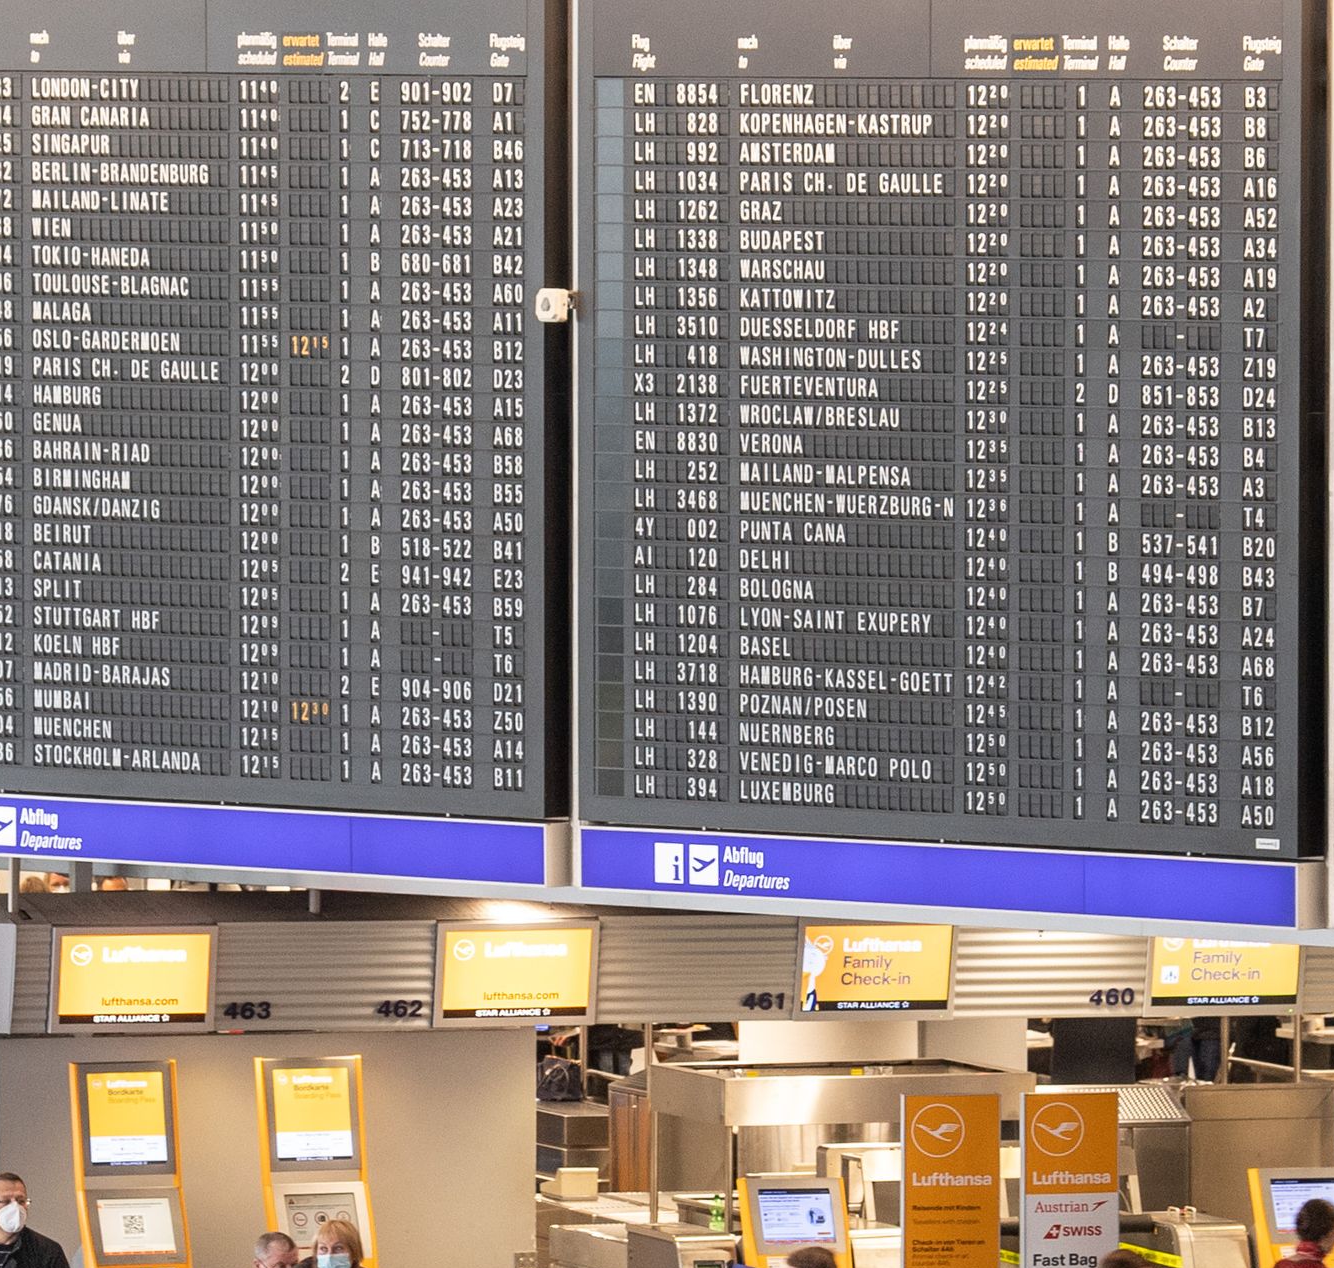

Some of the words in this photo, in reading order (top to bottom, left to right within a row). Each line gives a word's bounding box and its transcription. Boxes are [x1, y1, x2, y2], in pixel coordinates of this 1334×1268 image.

[30, 77, 140, 99] LONDON-CITY
[400, 81, 473, 103] 901-902
[492, 82, 514, 103] D7
[634, 112, 656, 133] LH
[686, 112, 719, 133] 828
[738, 112, 934, 135] KOPENHAGEN-KASTRUP
[1142, 115, 1222, 138] 263-453
[1243, 116, 1267, 138] B8
[31, 133, 111, 155] SINGAPUR
[738, 142, 836, 164] AMSTERDAM
[30, 161, 210, 185] BERLIN-BRANDENBURG
[739, 200, 783, 221] GRAZ
[30, 217, 72, 238] WIEN
[738, 229, 826, 251] BUDAPEST
[31, 300, 93, 322] MALAGA
[32, 384, 102, 406] HAMBURG
[739, 374, 880, 398] FUERTEVENTURA
[738, 433, 804, 454] VERONA
[32, 467, 132, 490] BIRMINGHAM
[32, 495, 161, 519] GDANSK/DANZIG
[32, 522, 92, 544] BEIRUT
[739, 519, 793, 541] PUNTA
[803, 521, 847, 543] CANA
[739, 577, 815, 600] BOLOGNA
[739, 779, 835, 804] LUXEMBURG
[19, 807, 59, 830] Abflug
[20, 830, 83, 851] Departures
[722, 846, 764, 868] Abflug
[723, 869, 791, 891] Departures
[843, 937, 922, 953] Lufthansa
[843, 955, 893, 972] Family
[1192, 951, 1242, 968] Family
[840, 971, 911, 986] Check-in
[1190, 966, 1261, 982] Check-in
[101, 996, 179, 1006] lufthansa.com
[483, 990, 559, 1003] lufthansa.com
[742, 992, 785, 1011] 461
[860, 1001, 901, 1009] ALLIANCE
[1089, 988, 1135, 1007] 460
[1187, 996, 1209, 1005] STAR
[1210, 996, 1251, 1005] ALLIANCE
[92, 1014, 116, 1023] STAR
[117, 1014, 161, 1023] ALLIANCE
[223, 1001, 272, 1021] 463
[376, 1000, 423, 1018] 462
[475, 1009, 499, 1018] STAR
[500, 1008, 543, 1018] ALLIANCE
[911, 1172, 993, 1186] Lufthansa
[1032, 1170, 1112, 1185] Lufthansa
[1034, 1200, 1089, 1213] Austrian
[1062, 1225, 1103, 1237] SWISS
[1033, 1254, 1066, 1267] Fast
[1069, 1253, 1098, 1268] Bag
